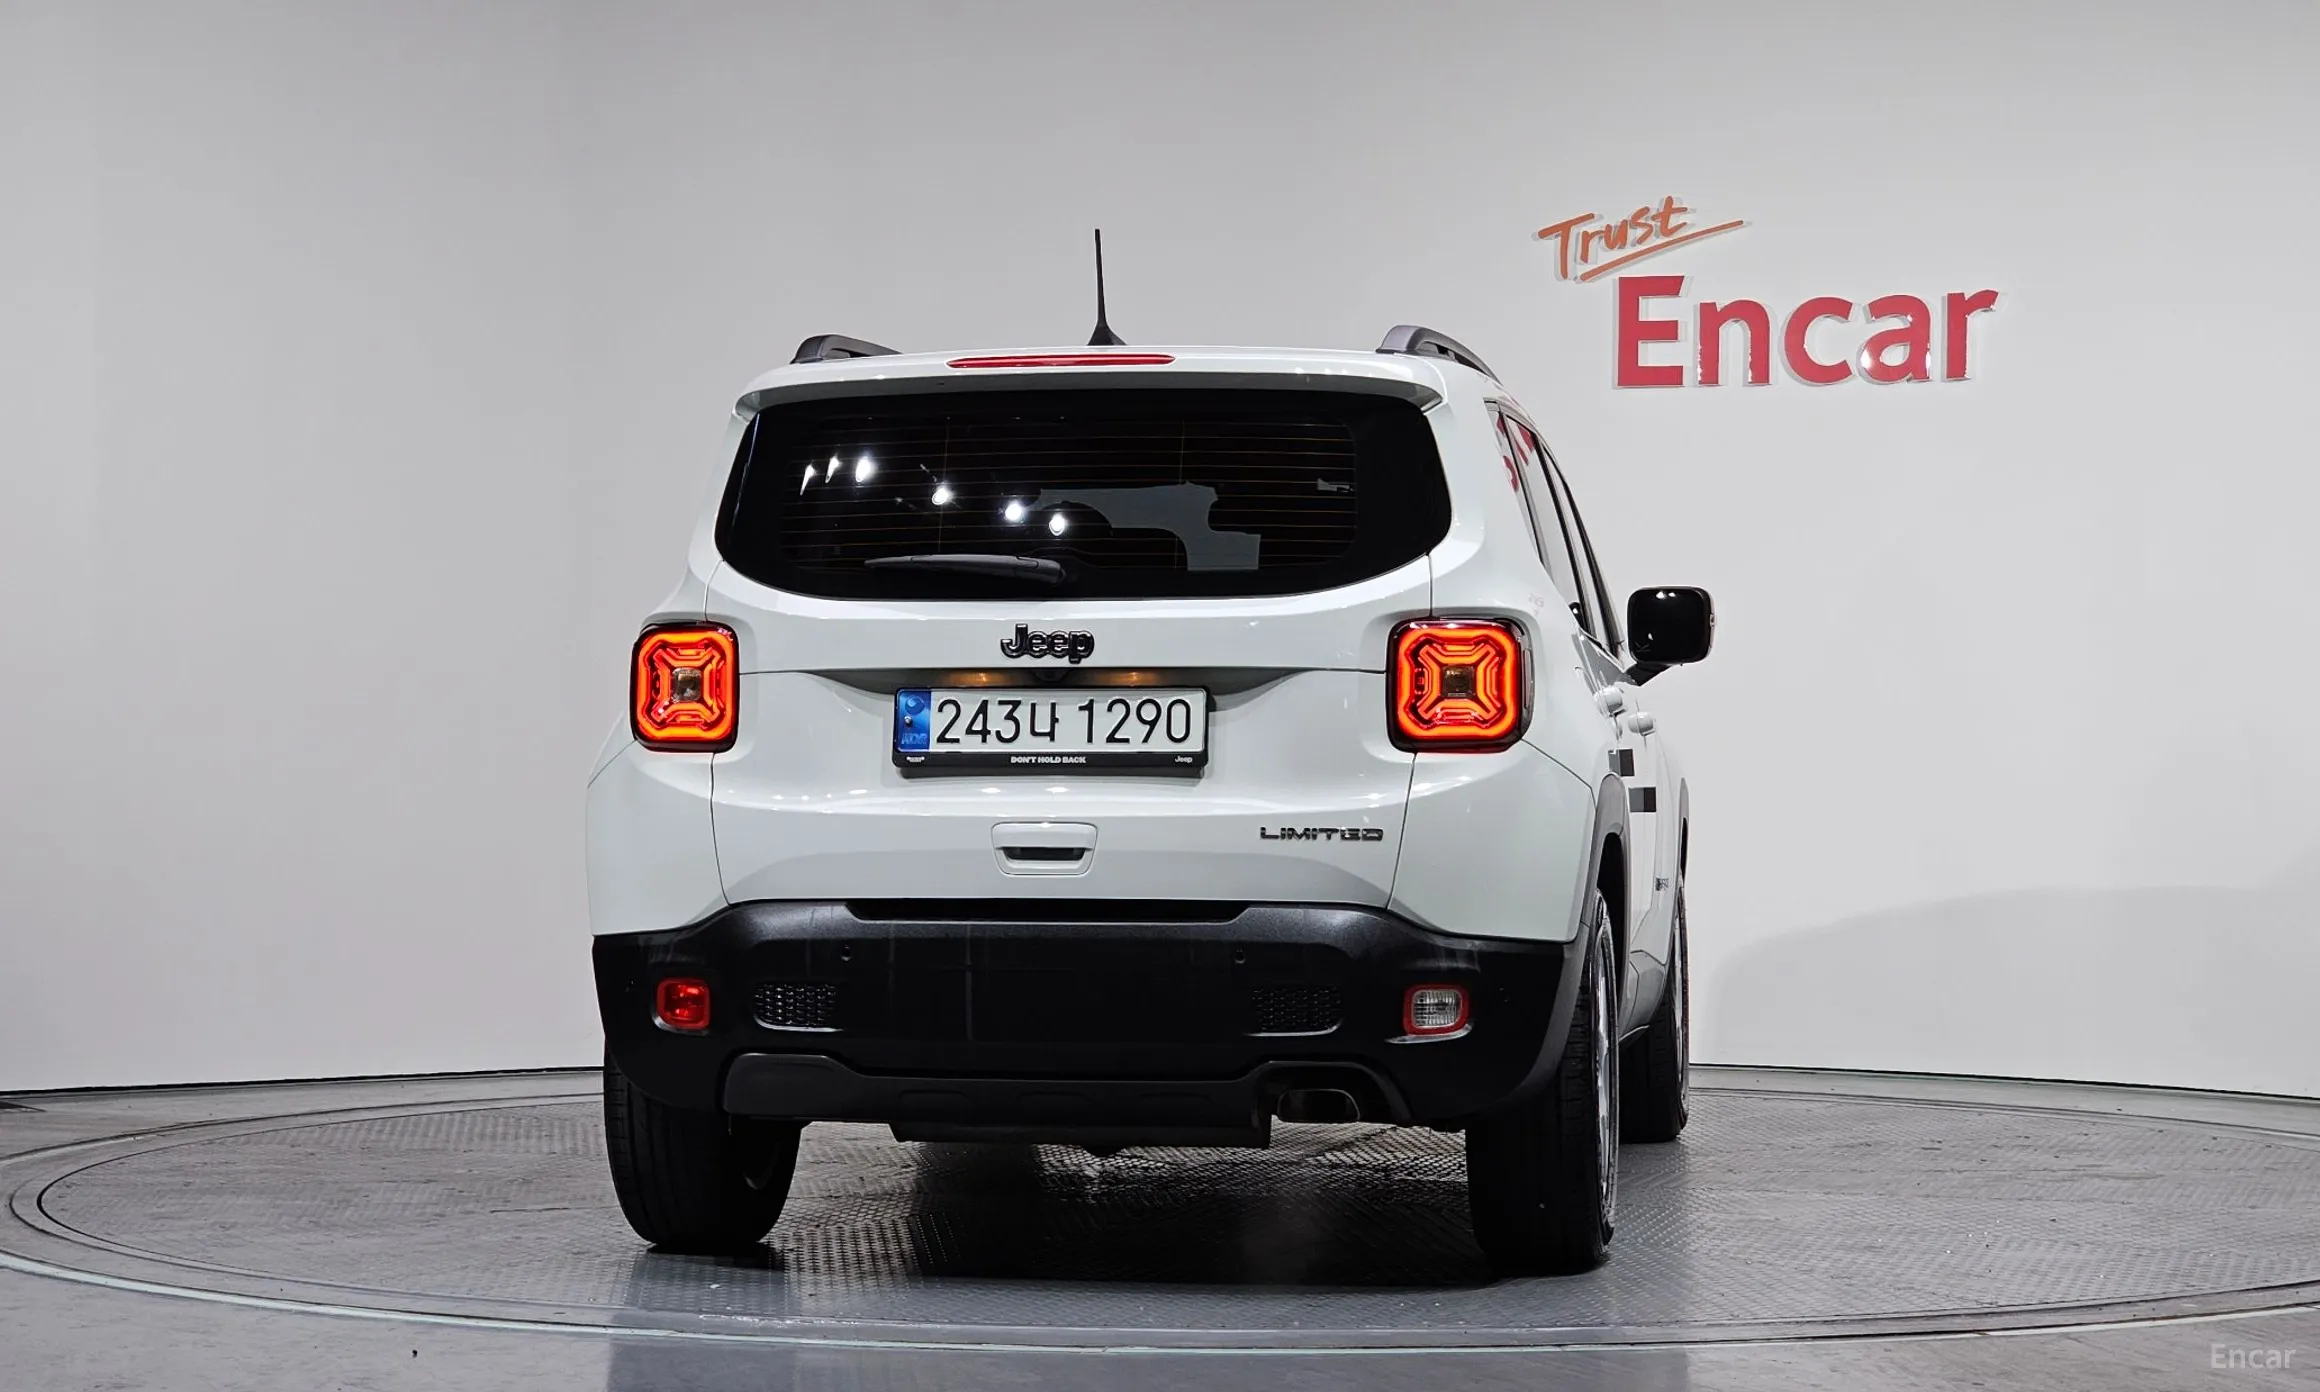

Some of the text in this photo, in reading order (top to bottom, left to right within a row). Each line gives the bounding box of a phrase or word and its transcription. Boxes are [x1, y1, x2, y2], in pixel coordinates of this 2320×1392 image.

[1537, 195, 1688, 279] Trust
[1616, 274, 2000, 388] Encar
[1000, 623, 1095, 664] Jeep
[936, 699, 1192, 744] 243나 1290
[1037, 756, 1062, 764] HOLD
[1062, 756, 1087, 764] BACK
[1174, 755, 1193, 764] Jeep
[1260, 826, 1384, 842] LIMITED
